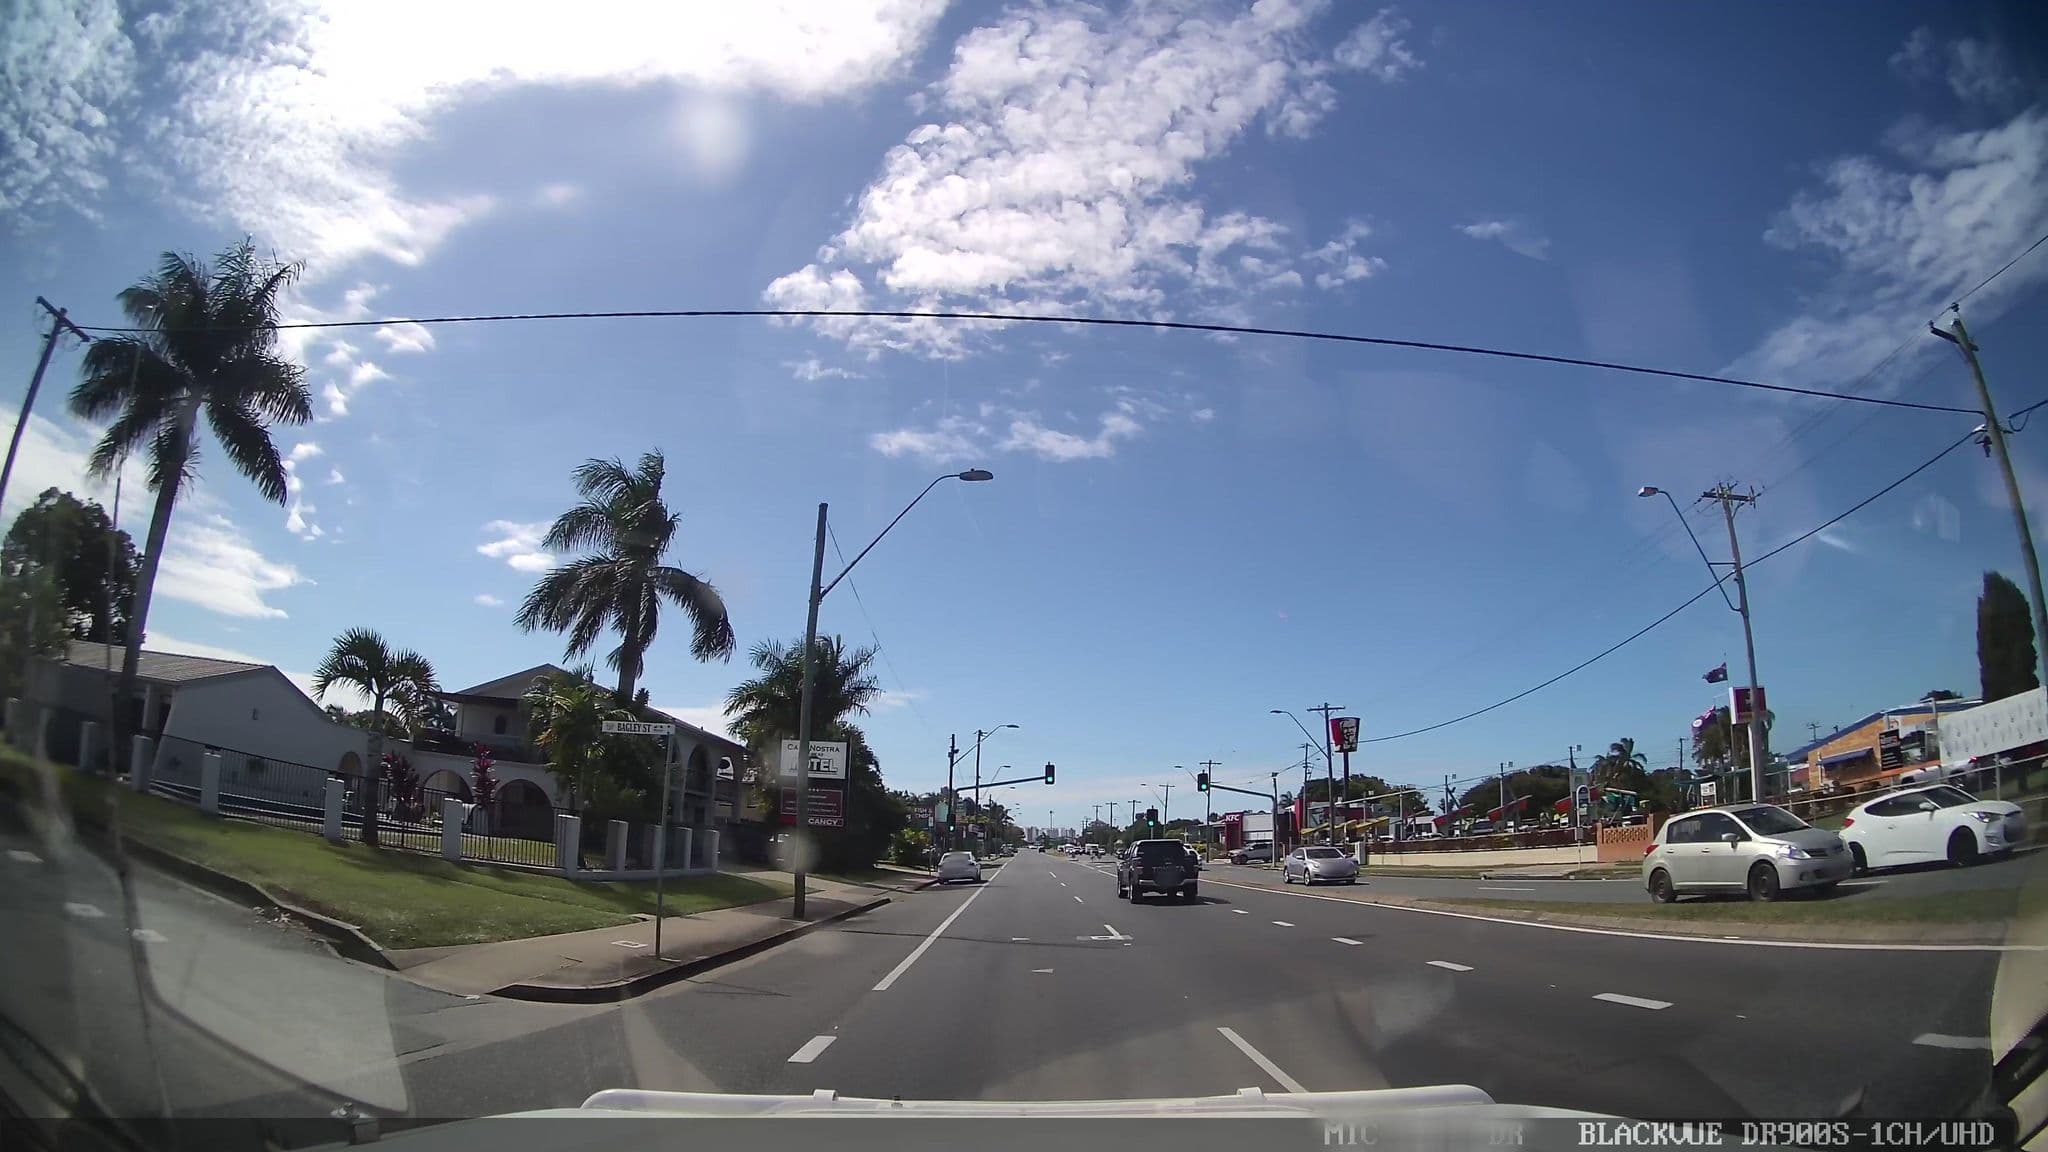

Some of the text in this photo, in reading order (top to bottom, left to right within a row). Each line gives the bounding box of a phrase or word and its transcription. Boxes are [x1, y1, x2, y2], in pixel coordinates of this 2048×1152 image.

[617, 722, 641, 733] BAGLEY
[642, 723, 652, 733] ST
[808, 818, 838, 826] CANCY
[1225, 814, 1240, 822] KFC
